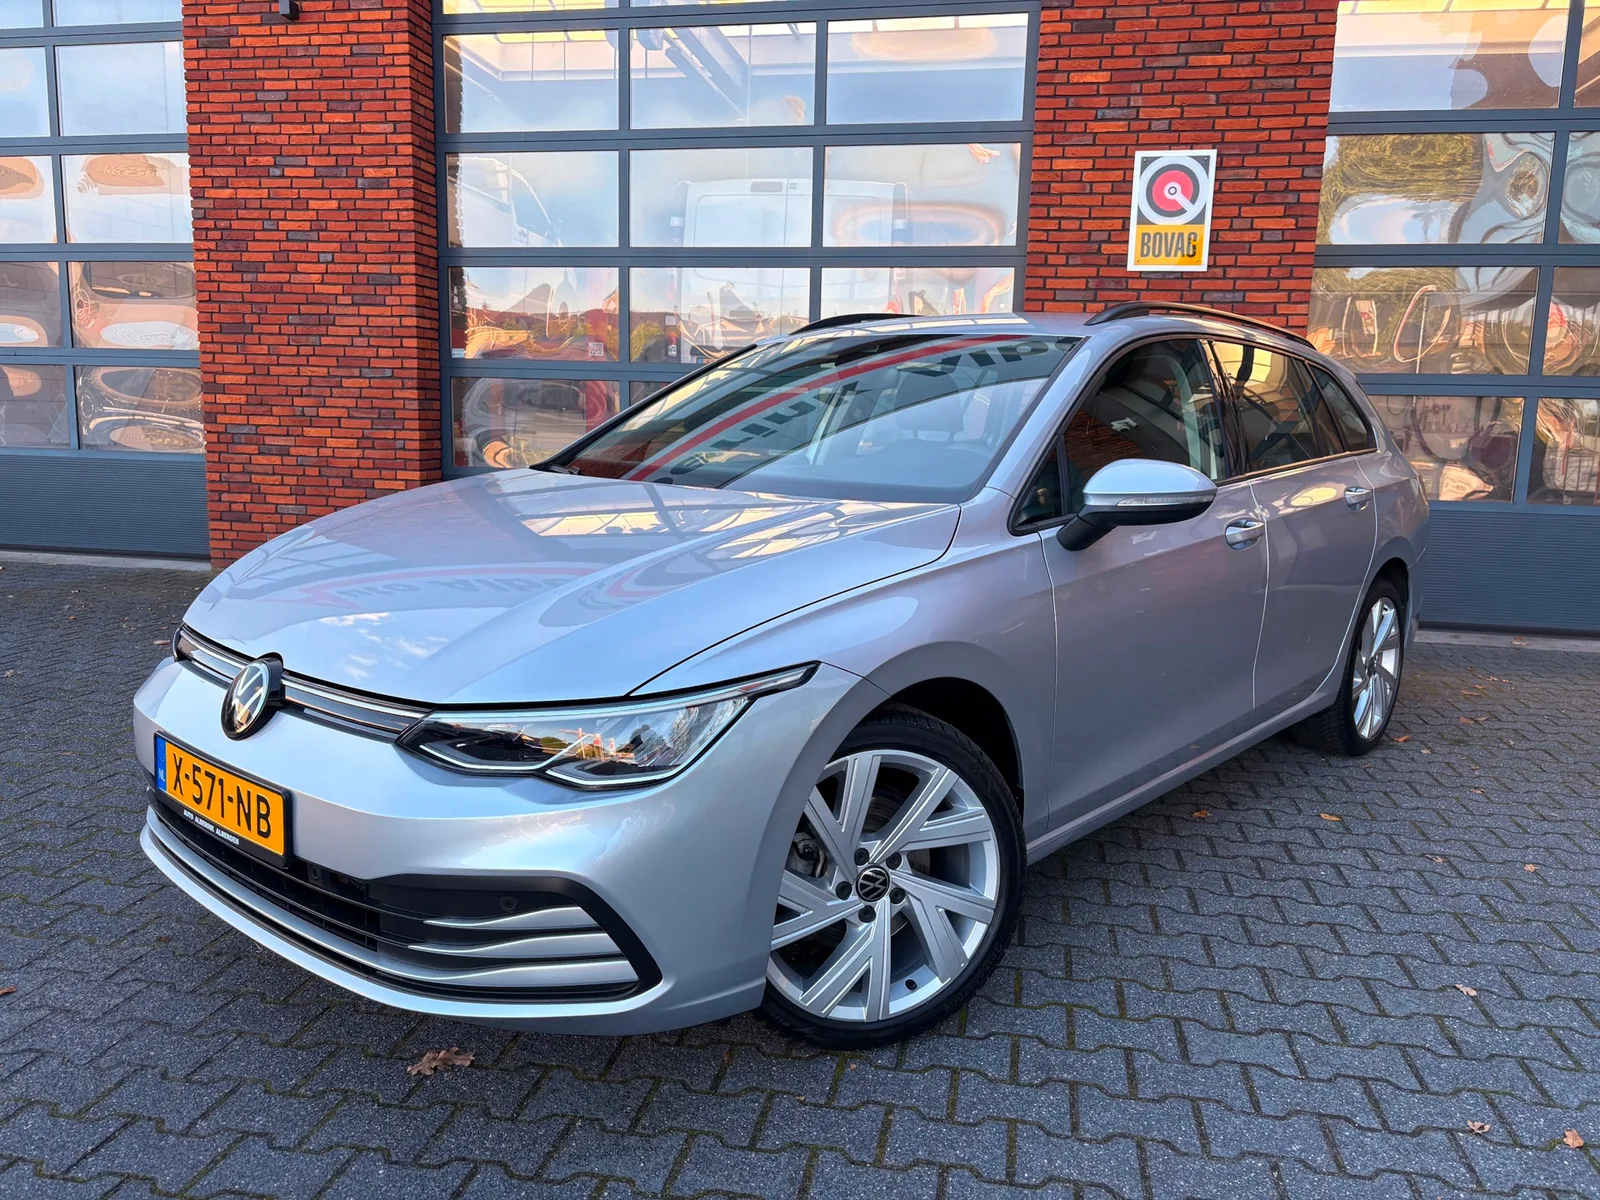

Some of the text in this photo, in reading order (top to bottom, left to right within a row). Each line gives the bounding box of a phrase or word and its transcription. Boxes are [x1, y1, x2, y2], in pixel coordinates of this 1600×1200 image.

[1140, 231, 1197, 258] BOVAG
[157, 767, 165, 782] NL
[172, 752, 272, 839] X-571-NB
